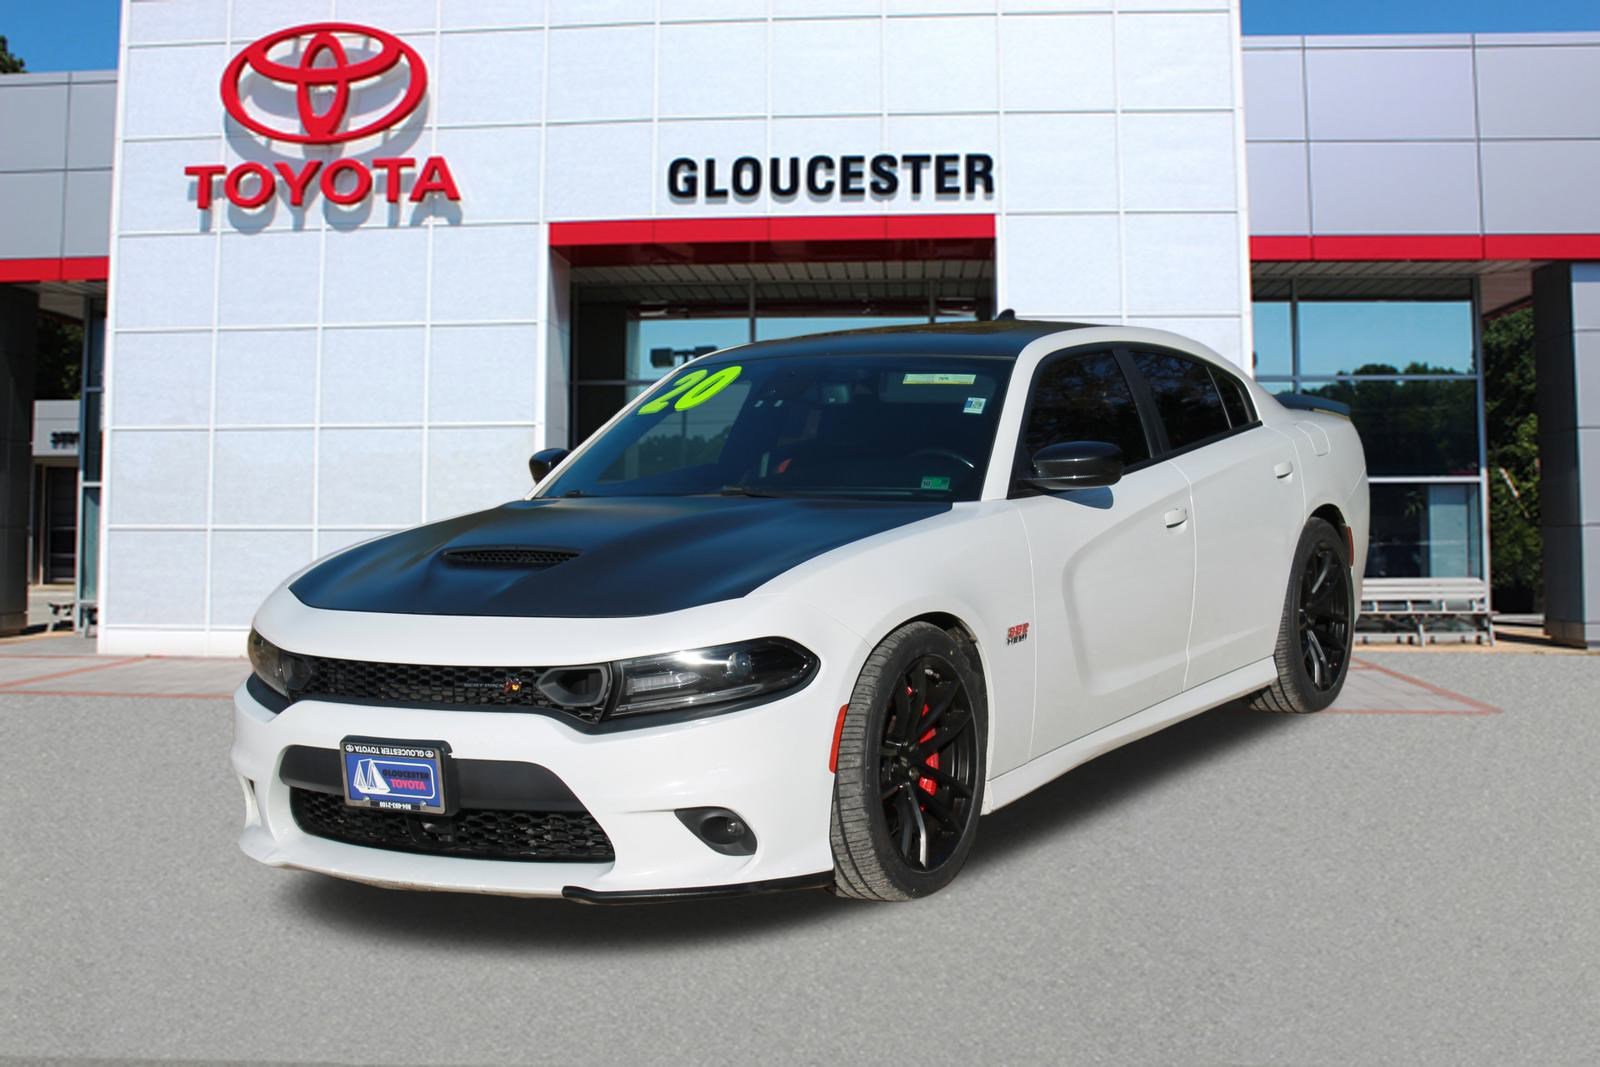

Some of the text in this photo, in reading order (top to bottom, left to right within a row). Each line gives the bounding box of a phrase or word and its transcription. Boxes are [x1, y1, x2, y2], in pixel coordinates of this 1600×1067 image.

[184, 156, 461, 210] TOYOTA
[667, 154, 995, 199] GLOUCESTER
[637, 365, 742, 415] 20
[354, 745, 425, 757] GLOUCESTER TOYOTA
[382, 769, 430, 780] GLOUCESTER
[390, 778, 426, 791] TOYOTA
